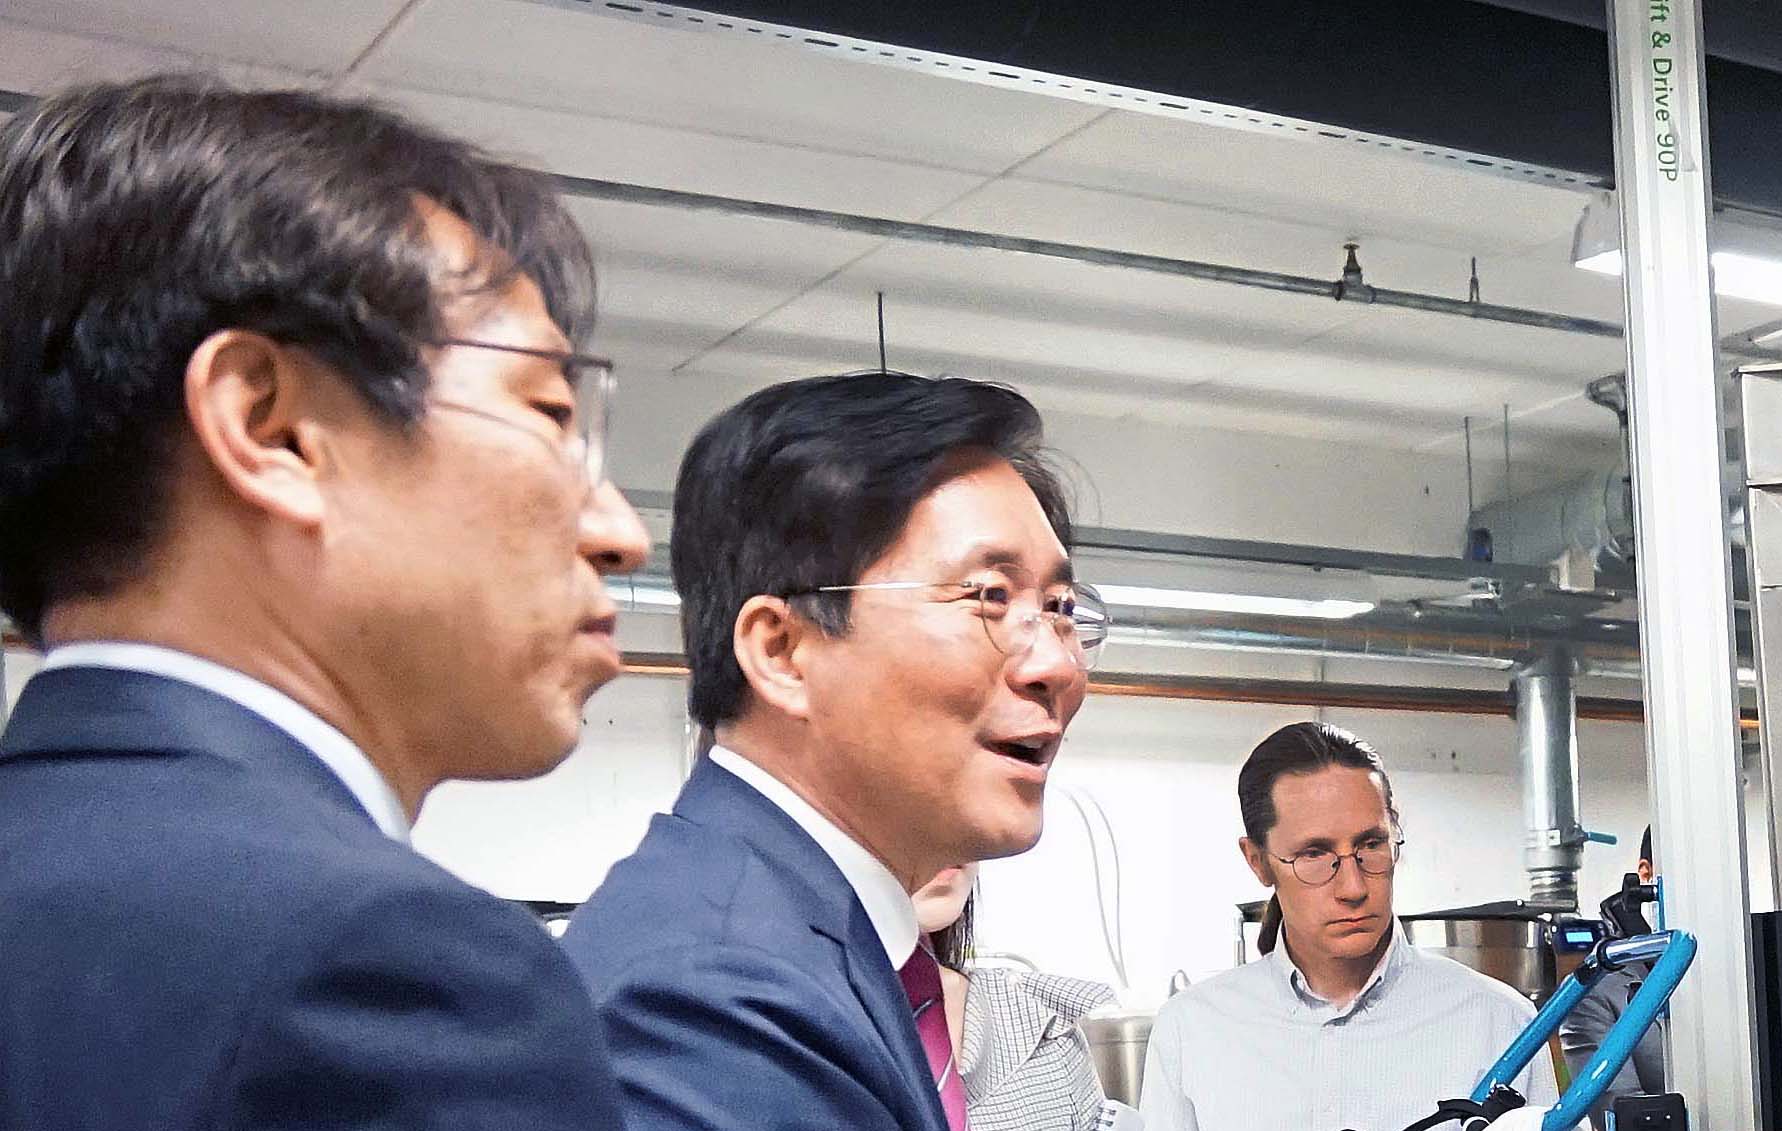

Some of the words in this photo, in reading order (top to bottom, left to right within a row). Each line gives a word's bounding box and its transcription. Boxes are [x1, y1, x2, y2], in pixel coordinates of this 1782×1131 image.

[1651, 31, 1671, 48] &
[1653, 58, 1674, 121] Drive
[1656, 133, 1678, 182] 90P
